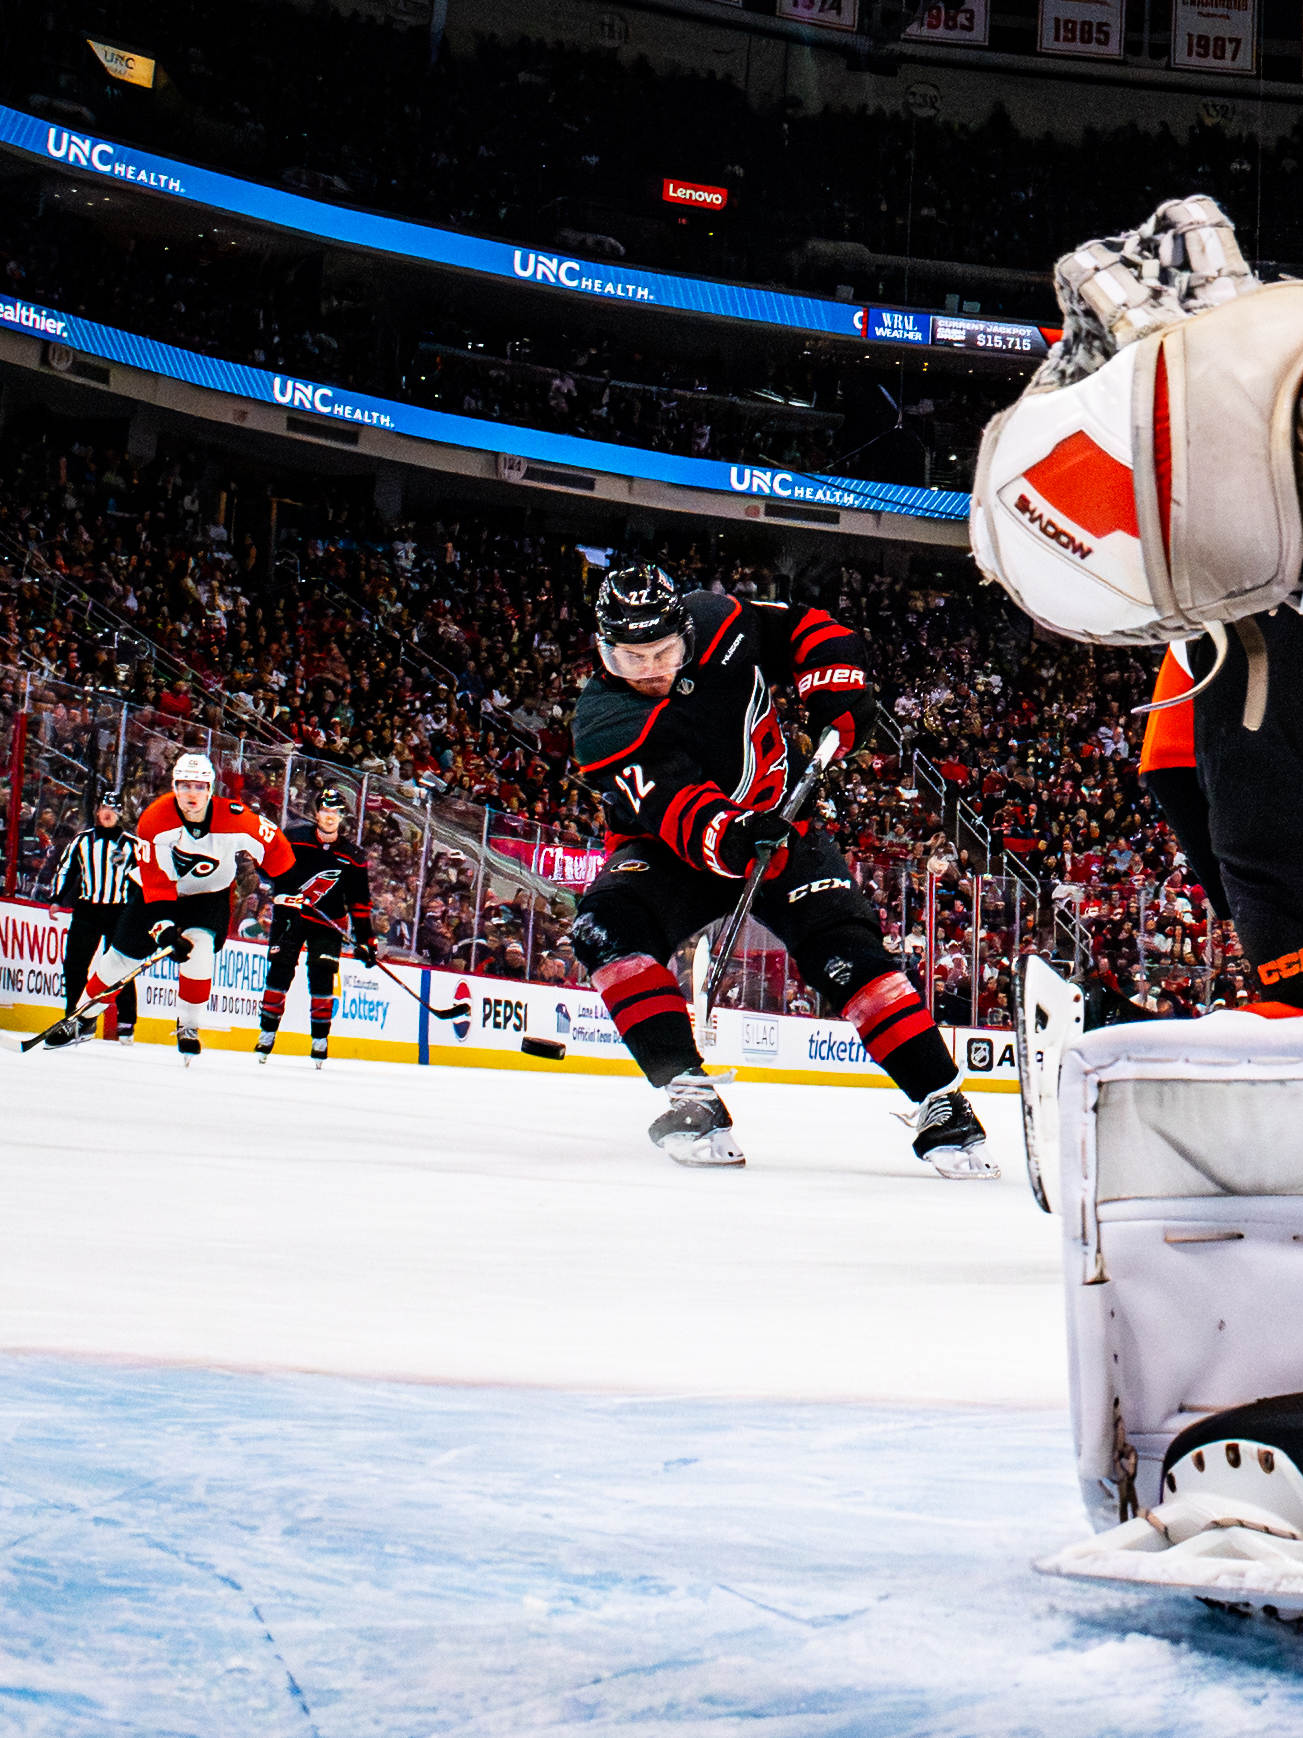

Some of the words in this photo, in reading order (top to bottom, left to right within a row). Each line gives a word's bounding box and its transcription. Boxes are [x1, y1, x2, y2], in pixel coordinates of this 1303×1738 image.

[1053, 17, 1111, 46] 1985
[1186, 32, 1242, 61] 1987
[47, 127, 114, 172] UNC
[669, 183, 722, 205] Lenovo
[513, 250, 580, 287] UNC
[875, 326, 922, 342] WEATHER
[882, 312, 918, 331] WRAL
[937, 320, 986, 332] CURRENT
[986, 325, 1033, 337] JACKPOT
[977, 333, 1032, 351] $15,715
[273, 376, 333, 413] UNC
[730, 467, 792, 497] UNC
[629, 589, 650, 605] 22
[789, 877, 851, 903] CCM
[0, 966, 24, 992] ING
[342, 990, 389, 1030] Lottery
[482, 998, 528, 1032] PEPSI
[745, 1023, 775, 1047] SILAC
